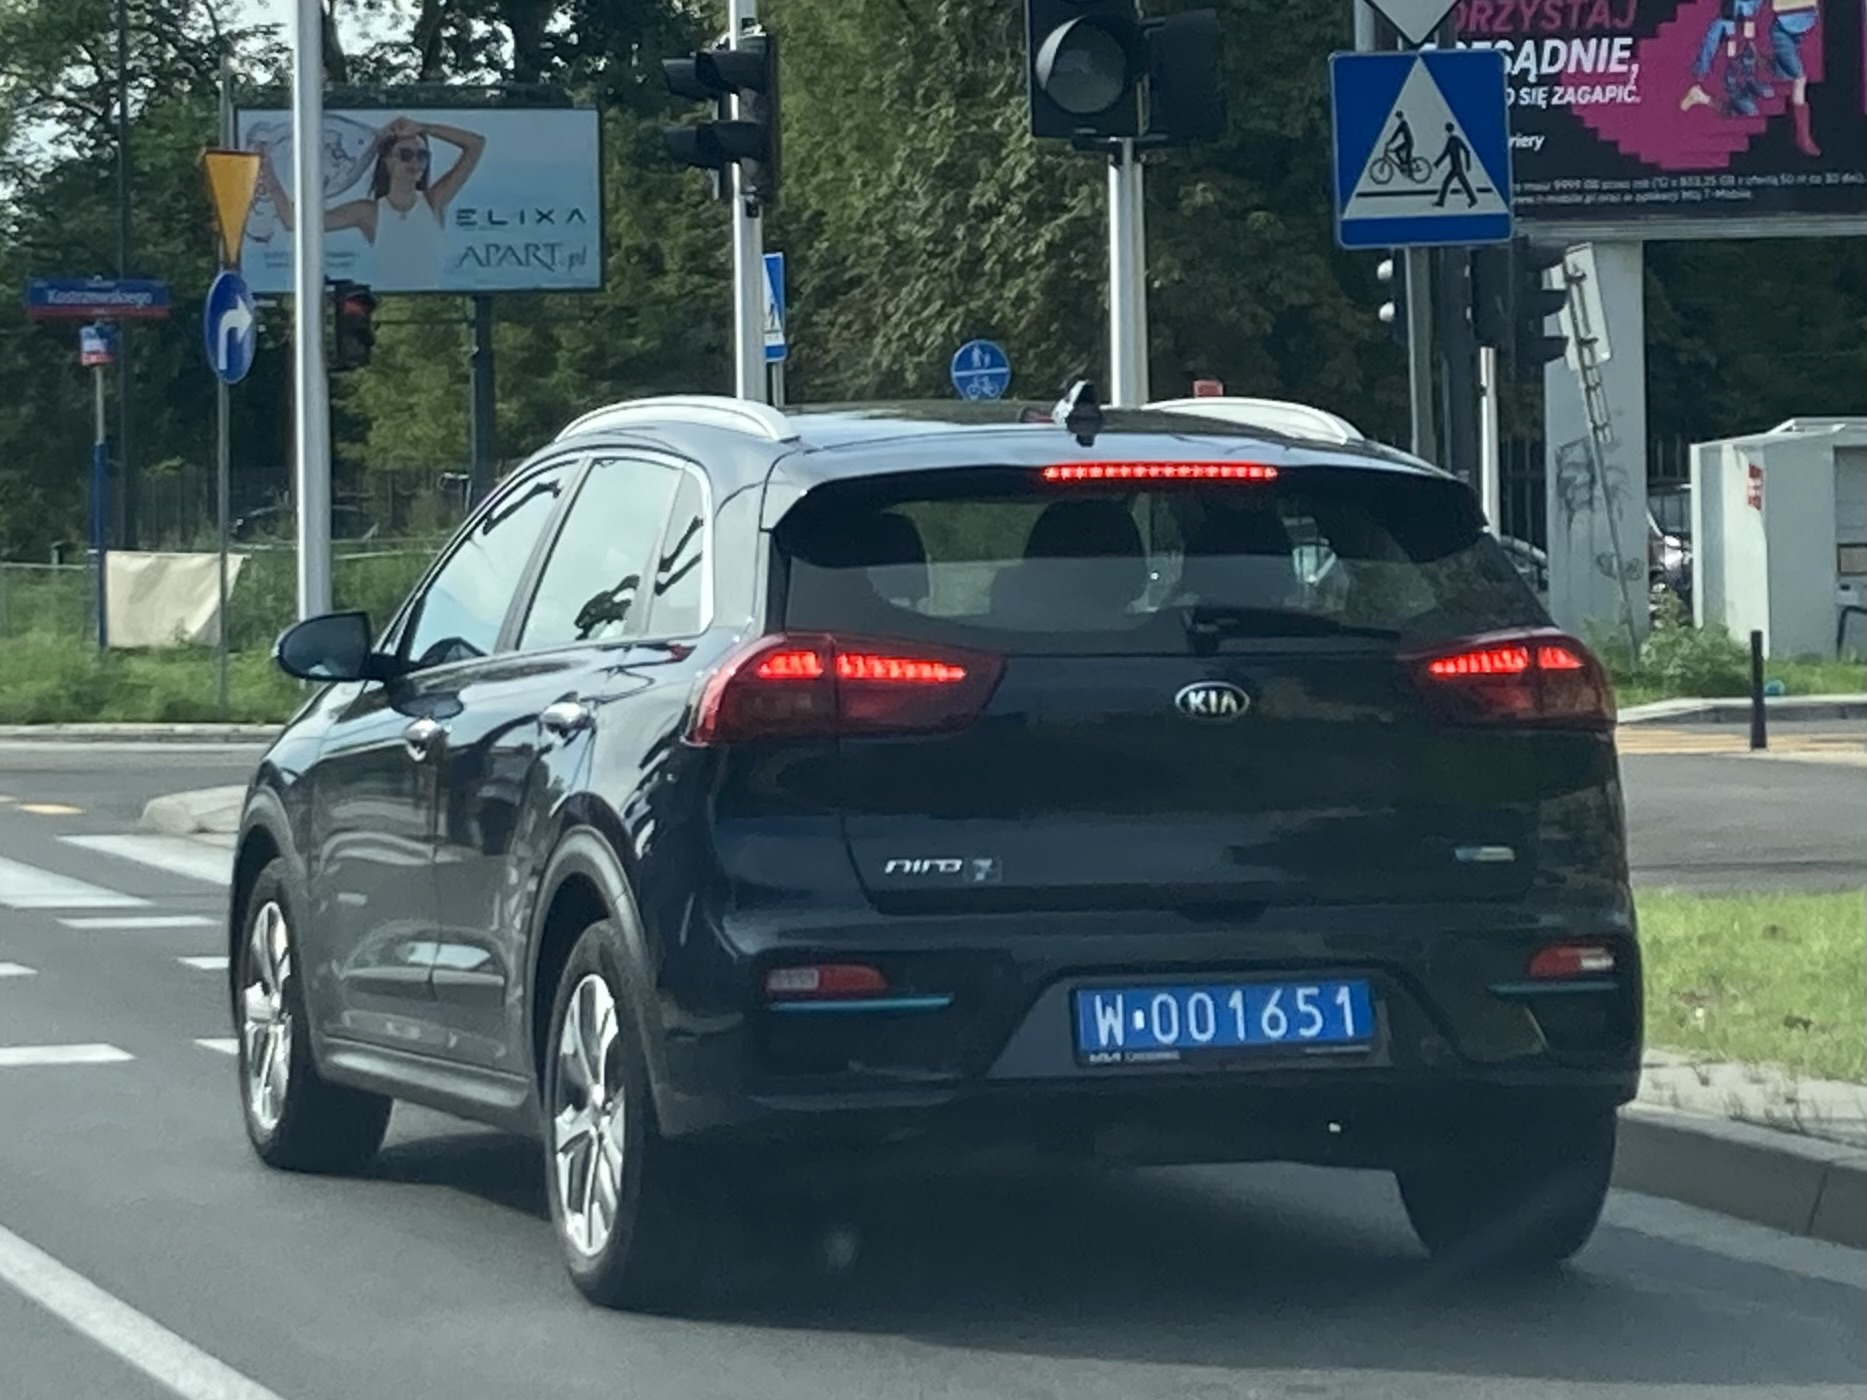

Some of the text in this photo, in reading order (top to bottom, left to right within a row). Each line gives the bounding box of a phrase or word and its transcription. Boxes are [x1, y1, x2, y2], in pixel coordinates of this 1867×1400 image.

[1519, 87, 1548, 109] SIĘ
[1188, 690, 1238, 713] KIA
[1095, 986, 1355, 1046] W 001651
